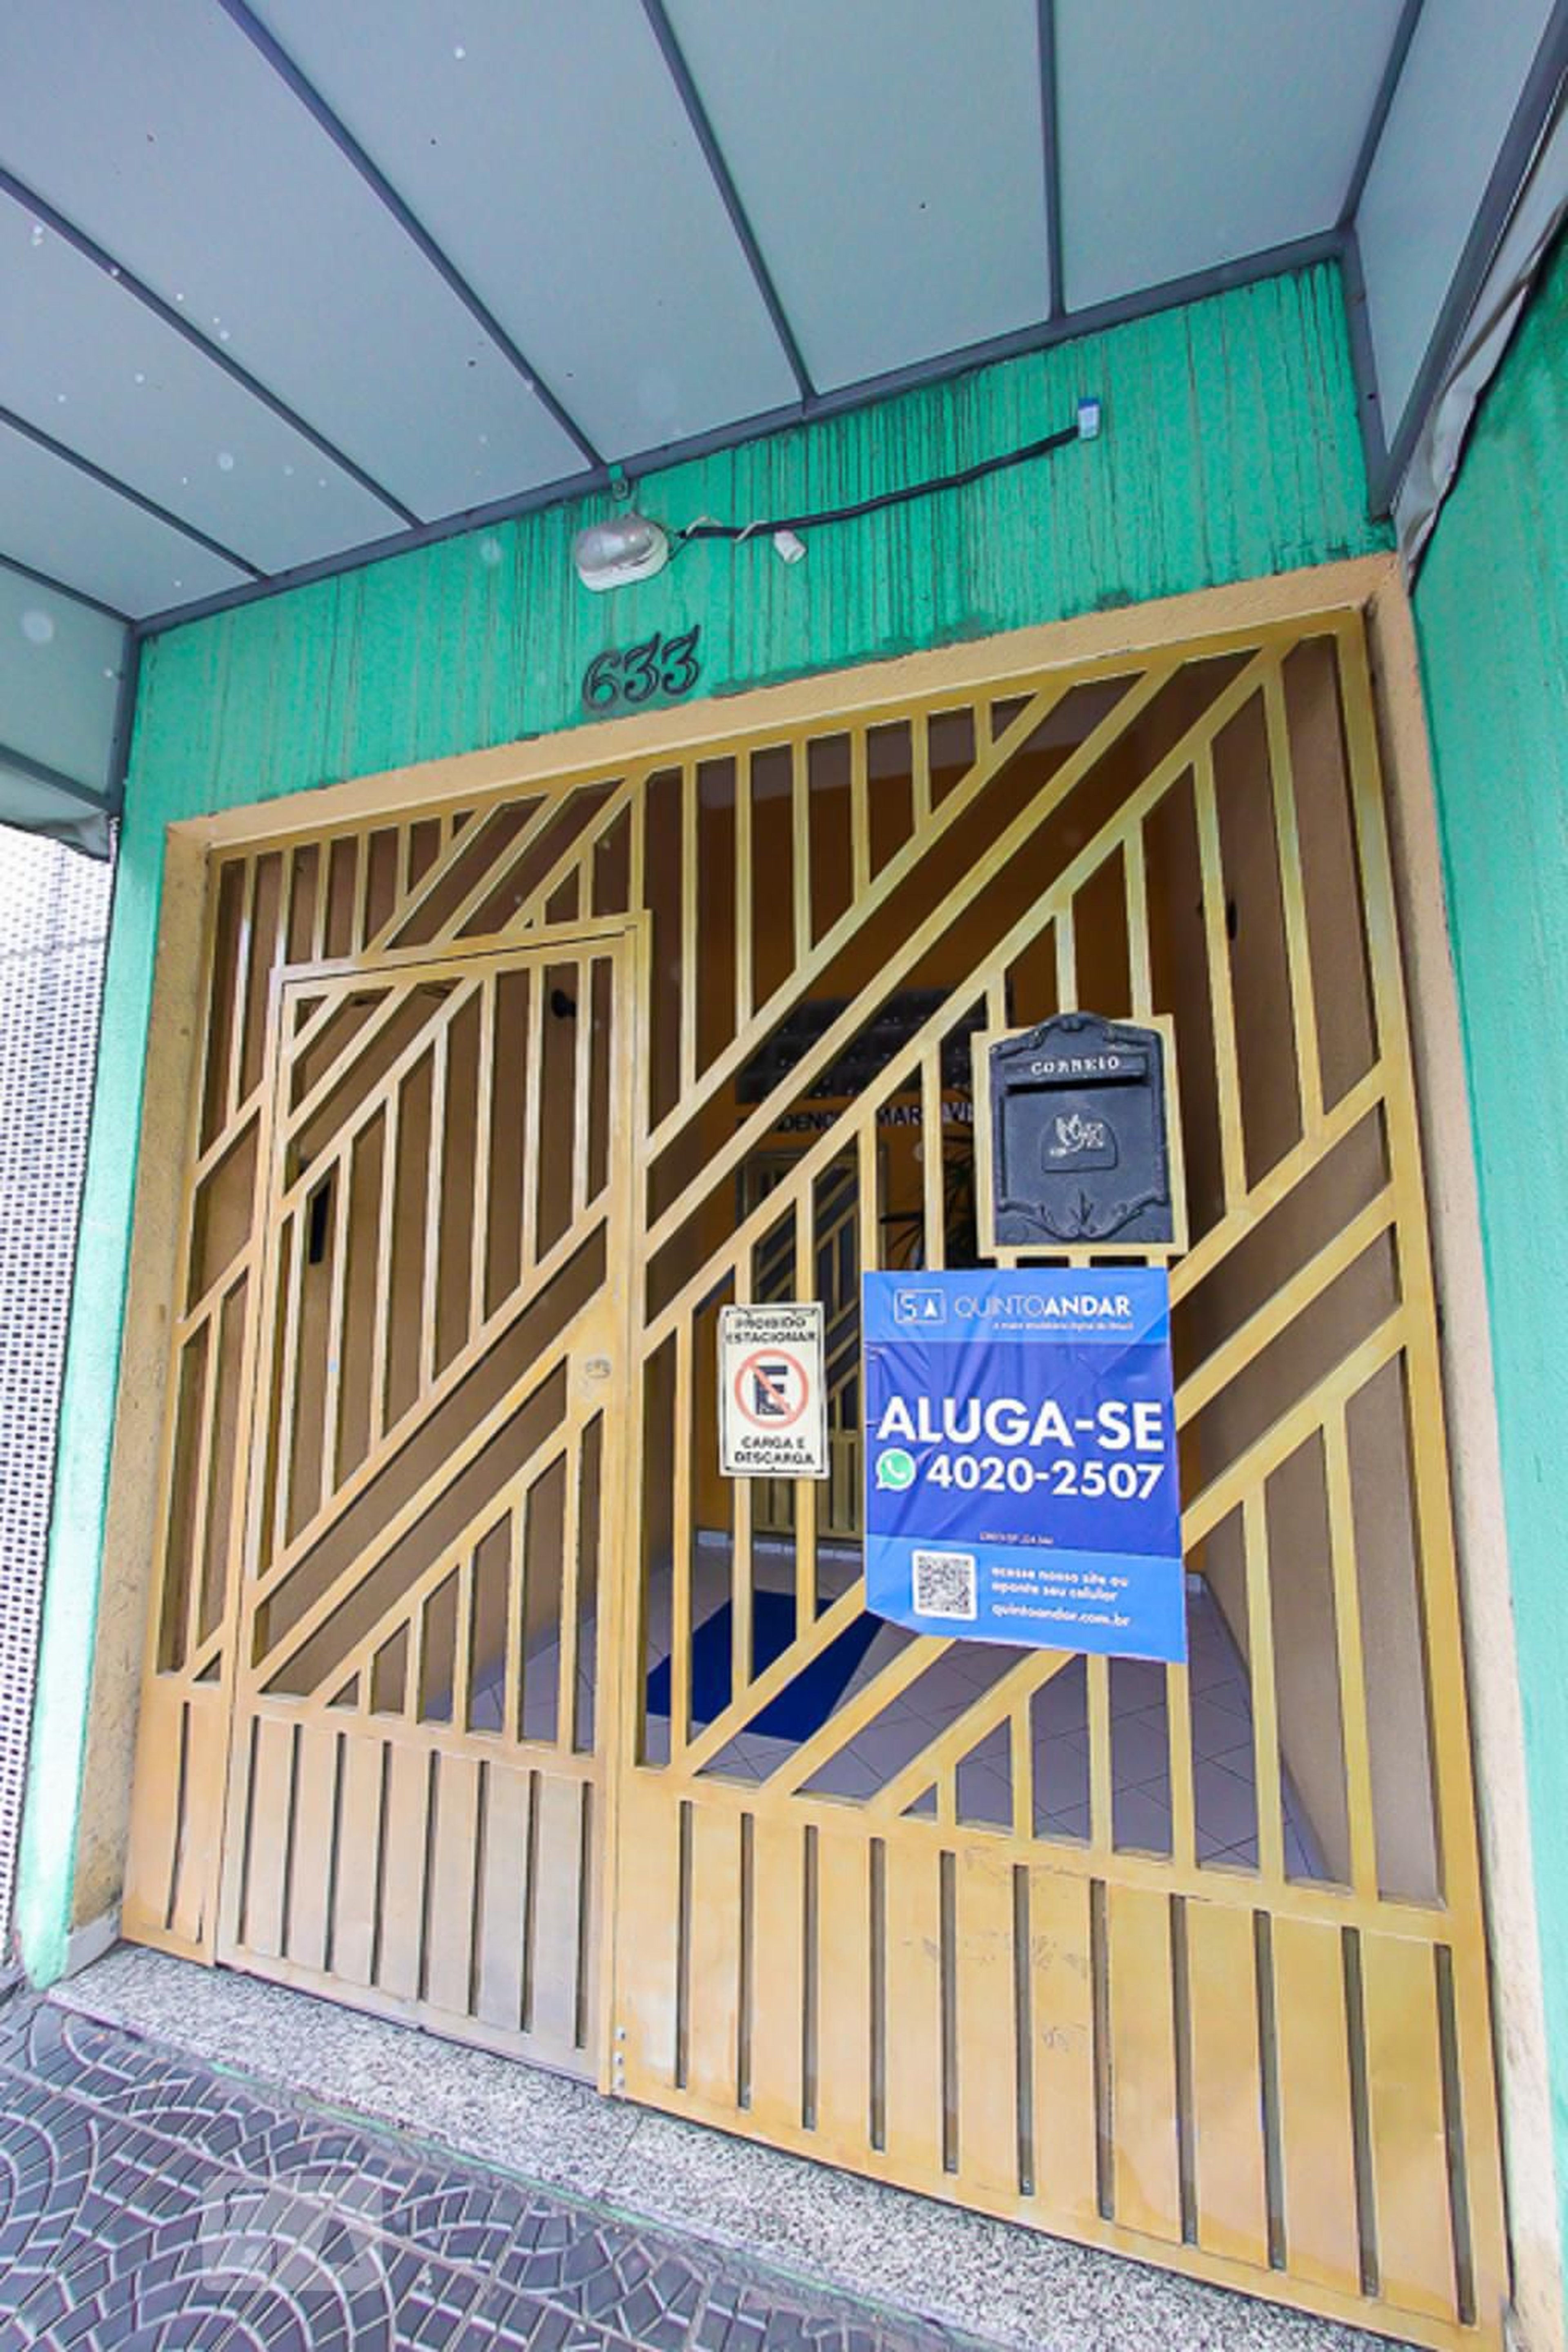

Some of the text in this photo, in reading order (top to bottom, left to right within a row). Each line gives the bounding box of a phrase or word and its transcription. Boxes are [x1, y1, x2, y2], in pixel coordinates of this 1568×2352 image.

[582, 624, 702, 711] 633
[1031, 1055, 1120, 1076] CORREIO
[954, 1294, 1132, 1319] QUINTOANDAR
[735, 1316, 806, 1329] PROIBIDO
[725, 1331, 815, 1344] ESTACIONAR
[876, 1396, 1165, 1451] ALUGA-SE
[741, 1435, 805, 1449] CARGA E
[734, 1450, 815, 1465] DESCARGA
[926, 1454, 1165, 1500] 4020-2507
[991, 1567, 1128, 1587] acesse nosso site ou
[991, 1582, 1119, 1602] aponte seu celular
[991, 1603, 1130, 1626] quintoandar.com.br
